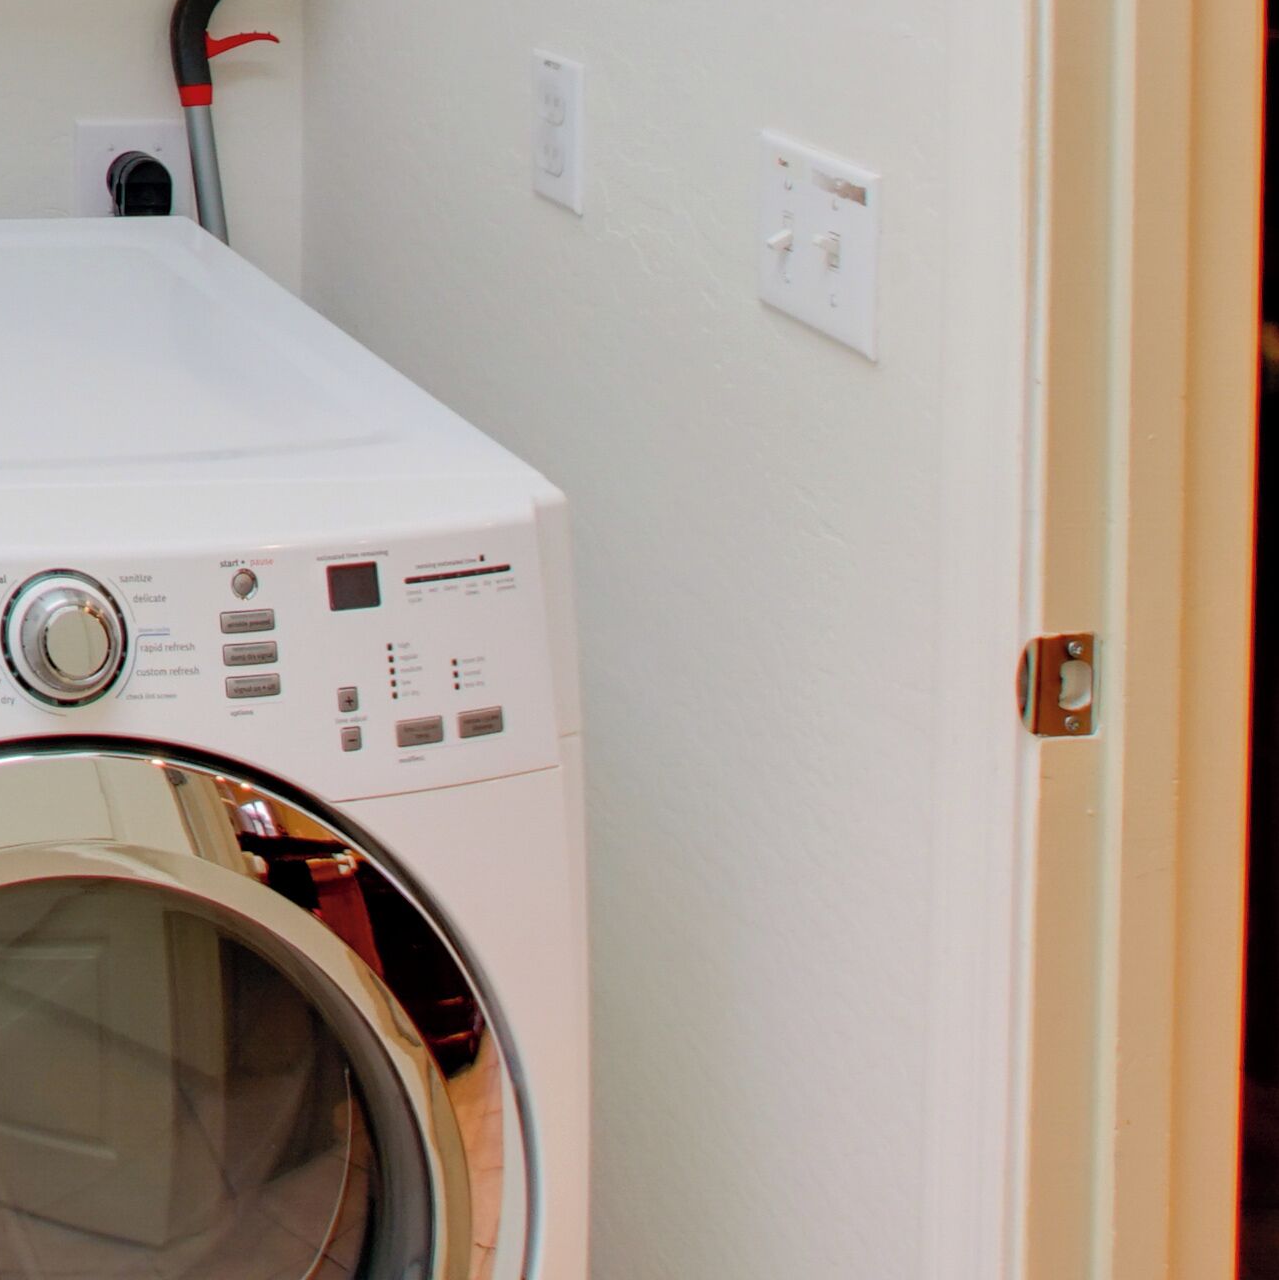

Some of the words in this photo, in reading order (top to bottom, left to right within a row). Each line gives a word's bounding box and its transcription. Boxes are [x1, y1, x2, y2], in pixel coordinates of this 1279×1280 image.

[219, 559, 239, 568] start
[249, 558, 275, 567] pause
[119, 574, 153, 583] sanitize
[132, 593, 167, 603] delicate
[140, 642, 162, 653] rapid
[164, 642, 196, 652] refresh
[136, 667, 167, 677] custom
[169, 665, 200, 676] refresh
[0, 695, 16, 705] dry
